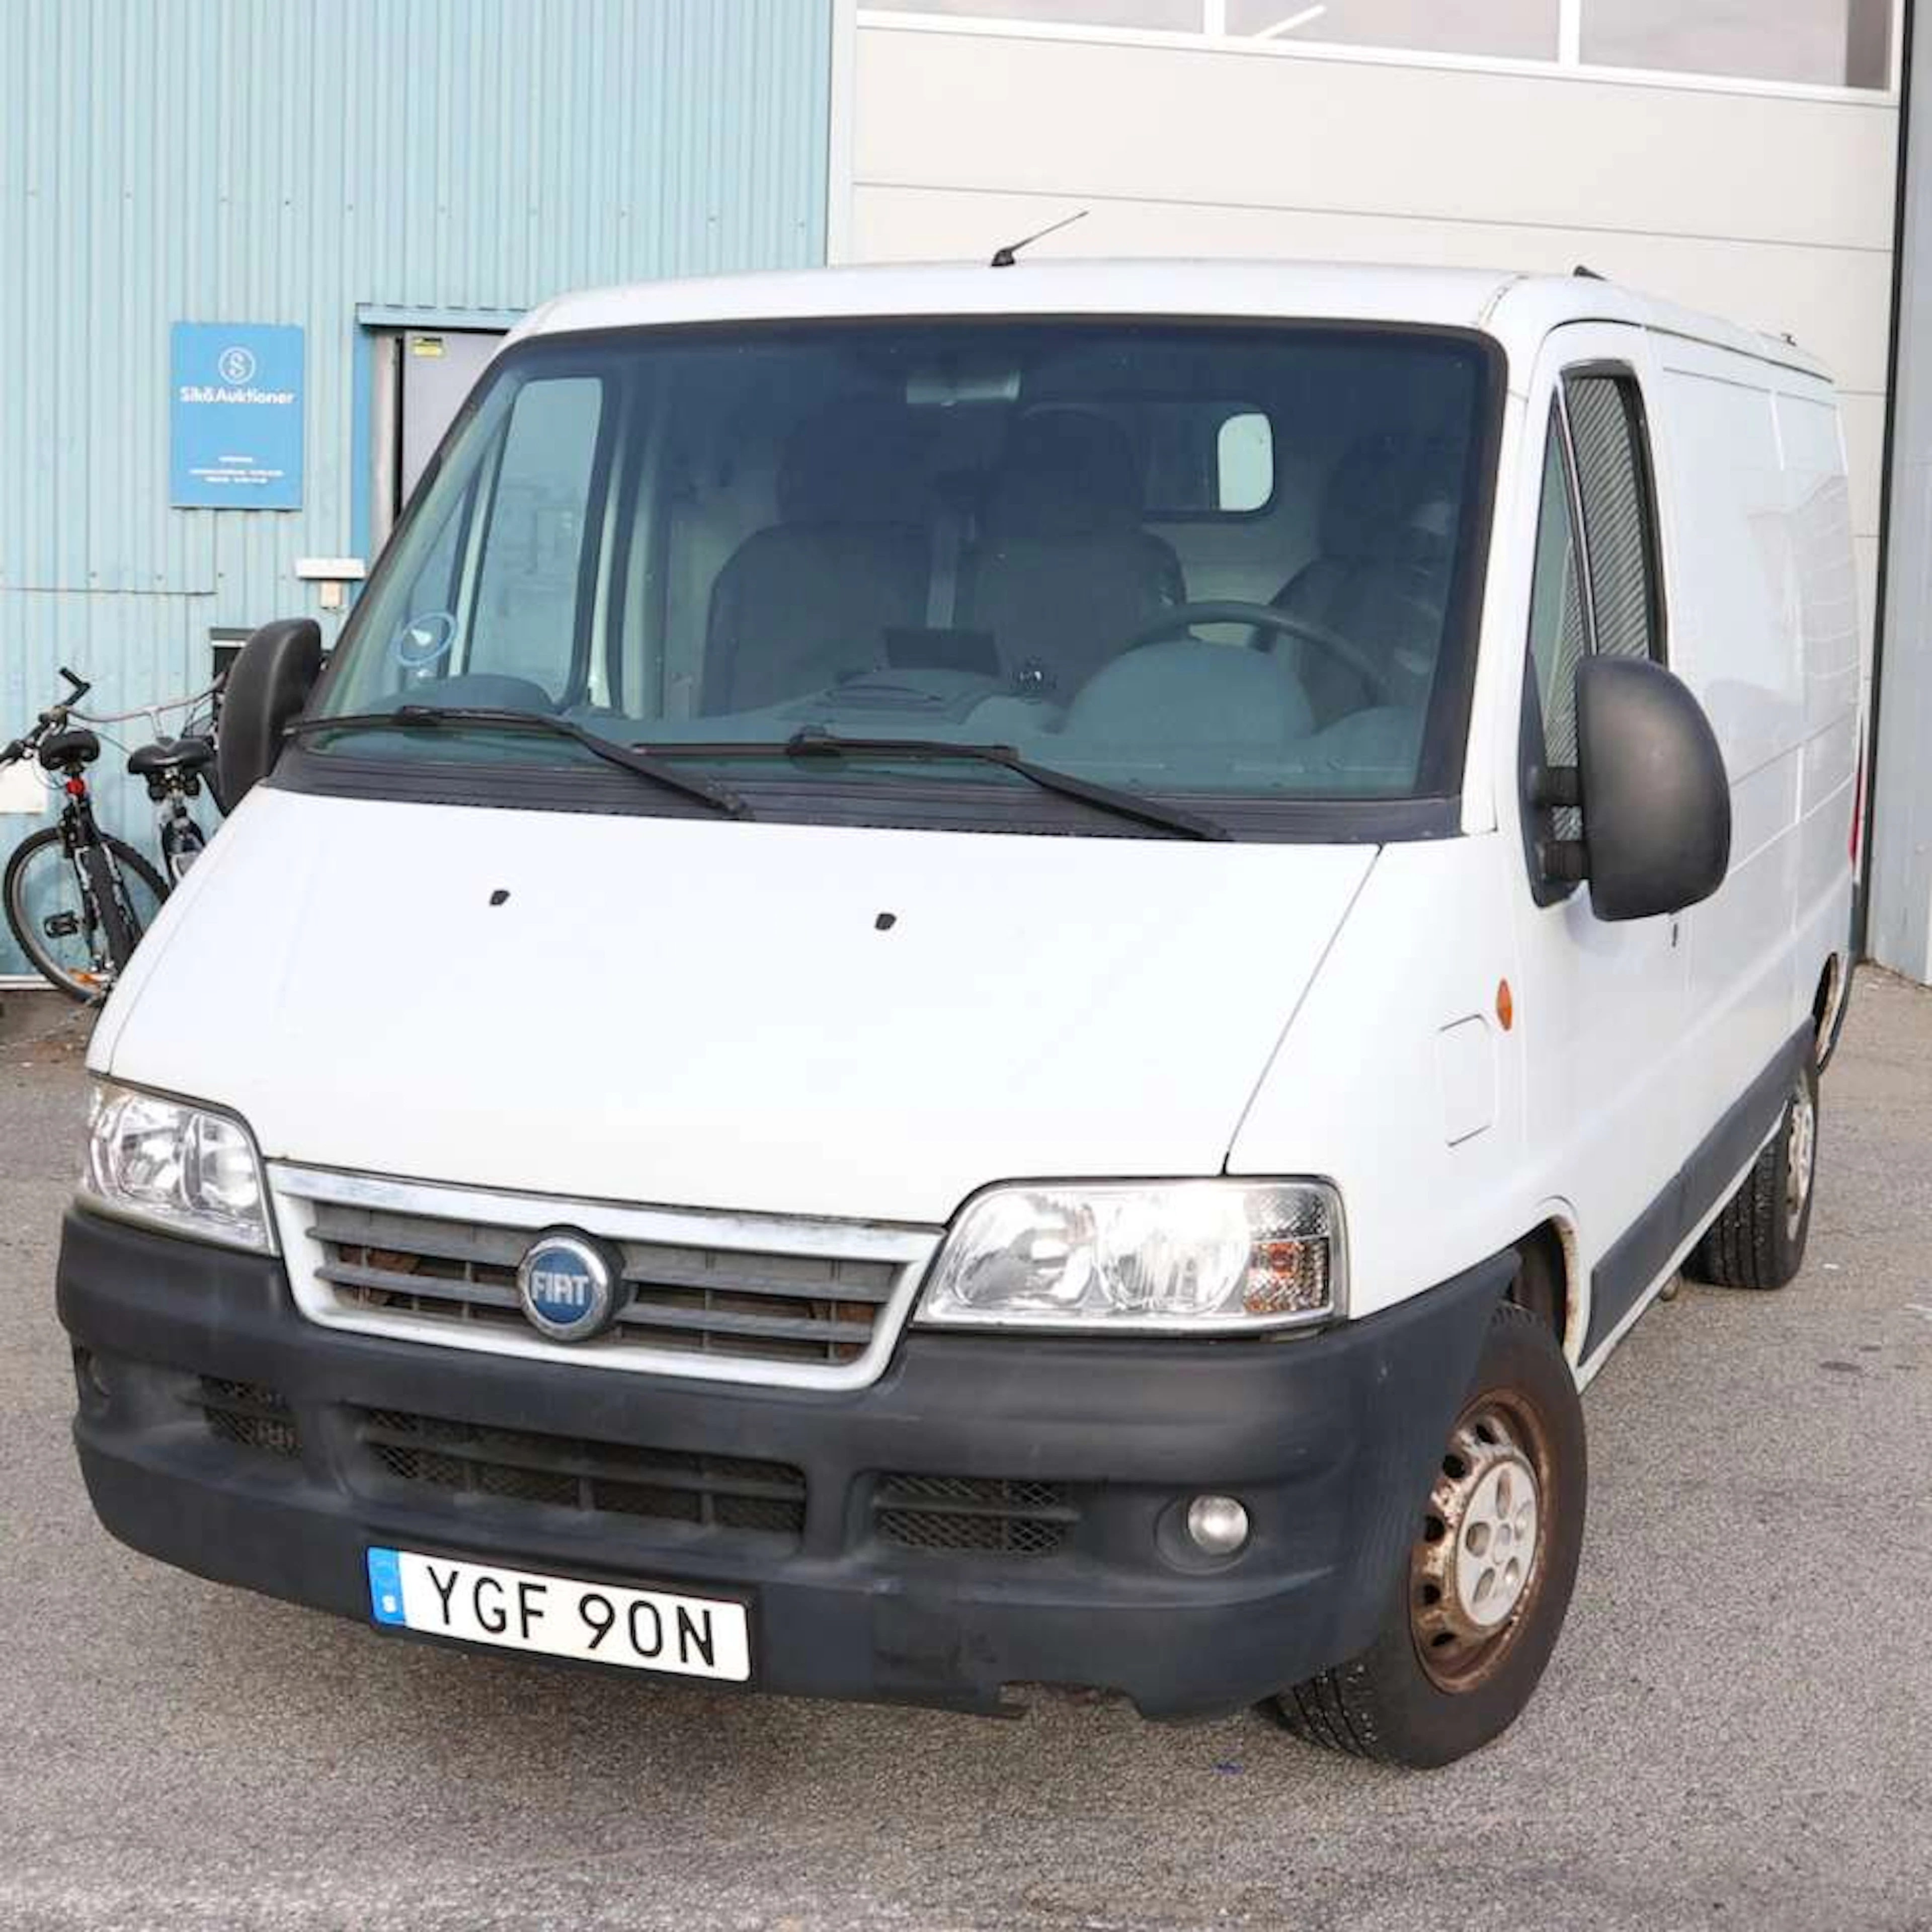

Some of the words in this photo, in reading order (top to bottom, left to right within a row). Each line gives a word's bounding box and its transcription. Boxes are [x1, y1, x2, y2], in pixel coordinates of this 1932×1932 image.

[531, 1270, 589, 1305] FIAT
[427, 1566, 547, 1638] YGF
[578, 1594, 714, 1666] 90N
